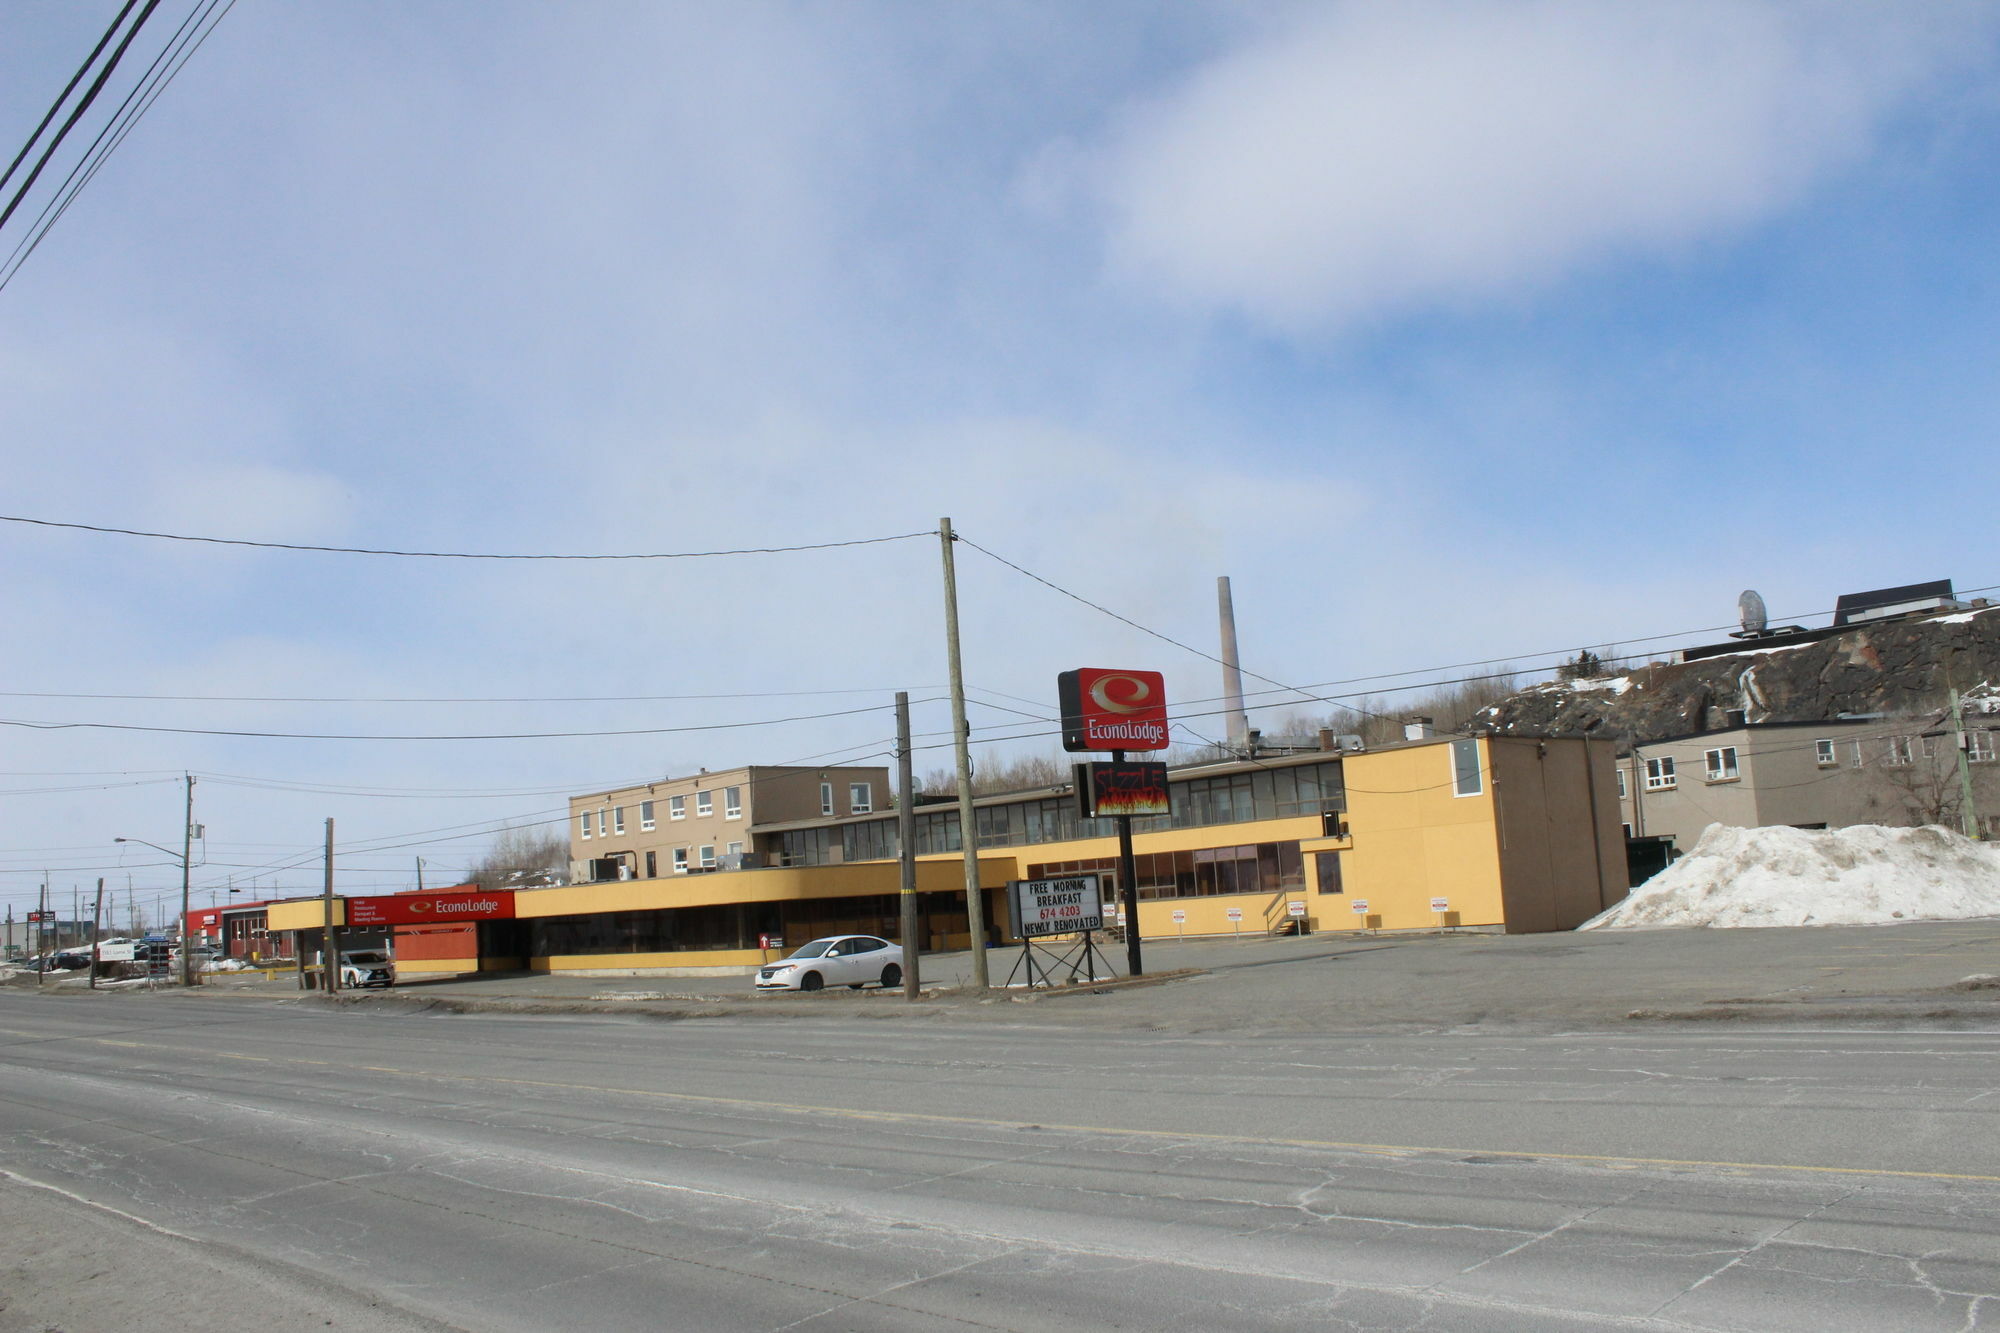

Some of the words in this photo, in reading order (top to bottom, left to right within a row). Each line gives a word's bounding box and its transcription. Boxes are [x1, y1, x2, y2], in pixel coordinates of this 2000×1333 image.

[1089, 719, 1164, 744] EconoLodge
[1029, 882, 1048, 895] FREE
[1053, 880, 1087, 892] MORNING
[435, 899, 498, 914] EconoLodge
[1036, 893, 1082, 907] BREAKFAST
[1040, 908, 1056, 920] 674
[1059, 905, 1081, 917] 4203
[1024, 921, 1051, 935] NEWLY
[1054, 916, 1099, 932] RENOVATED
